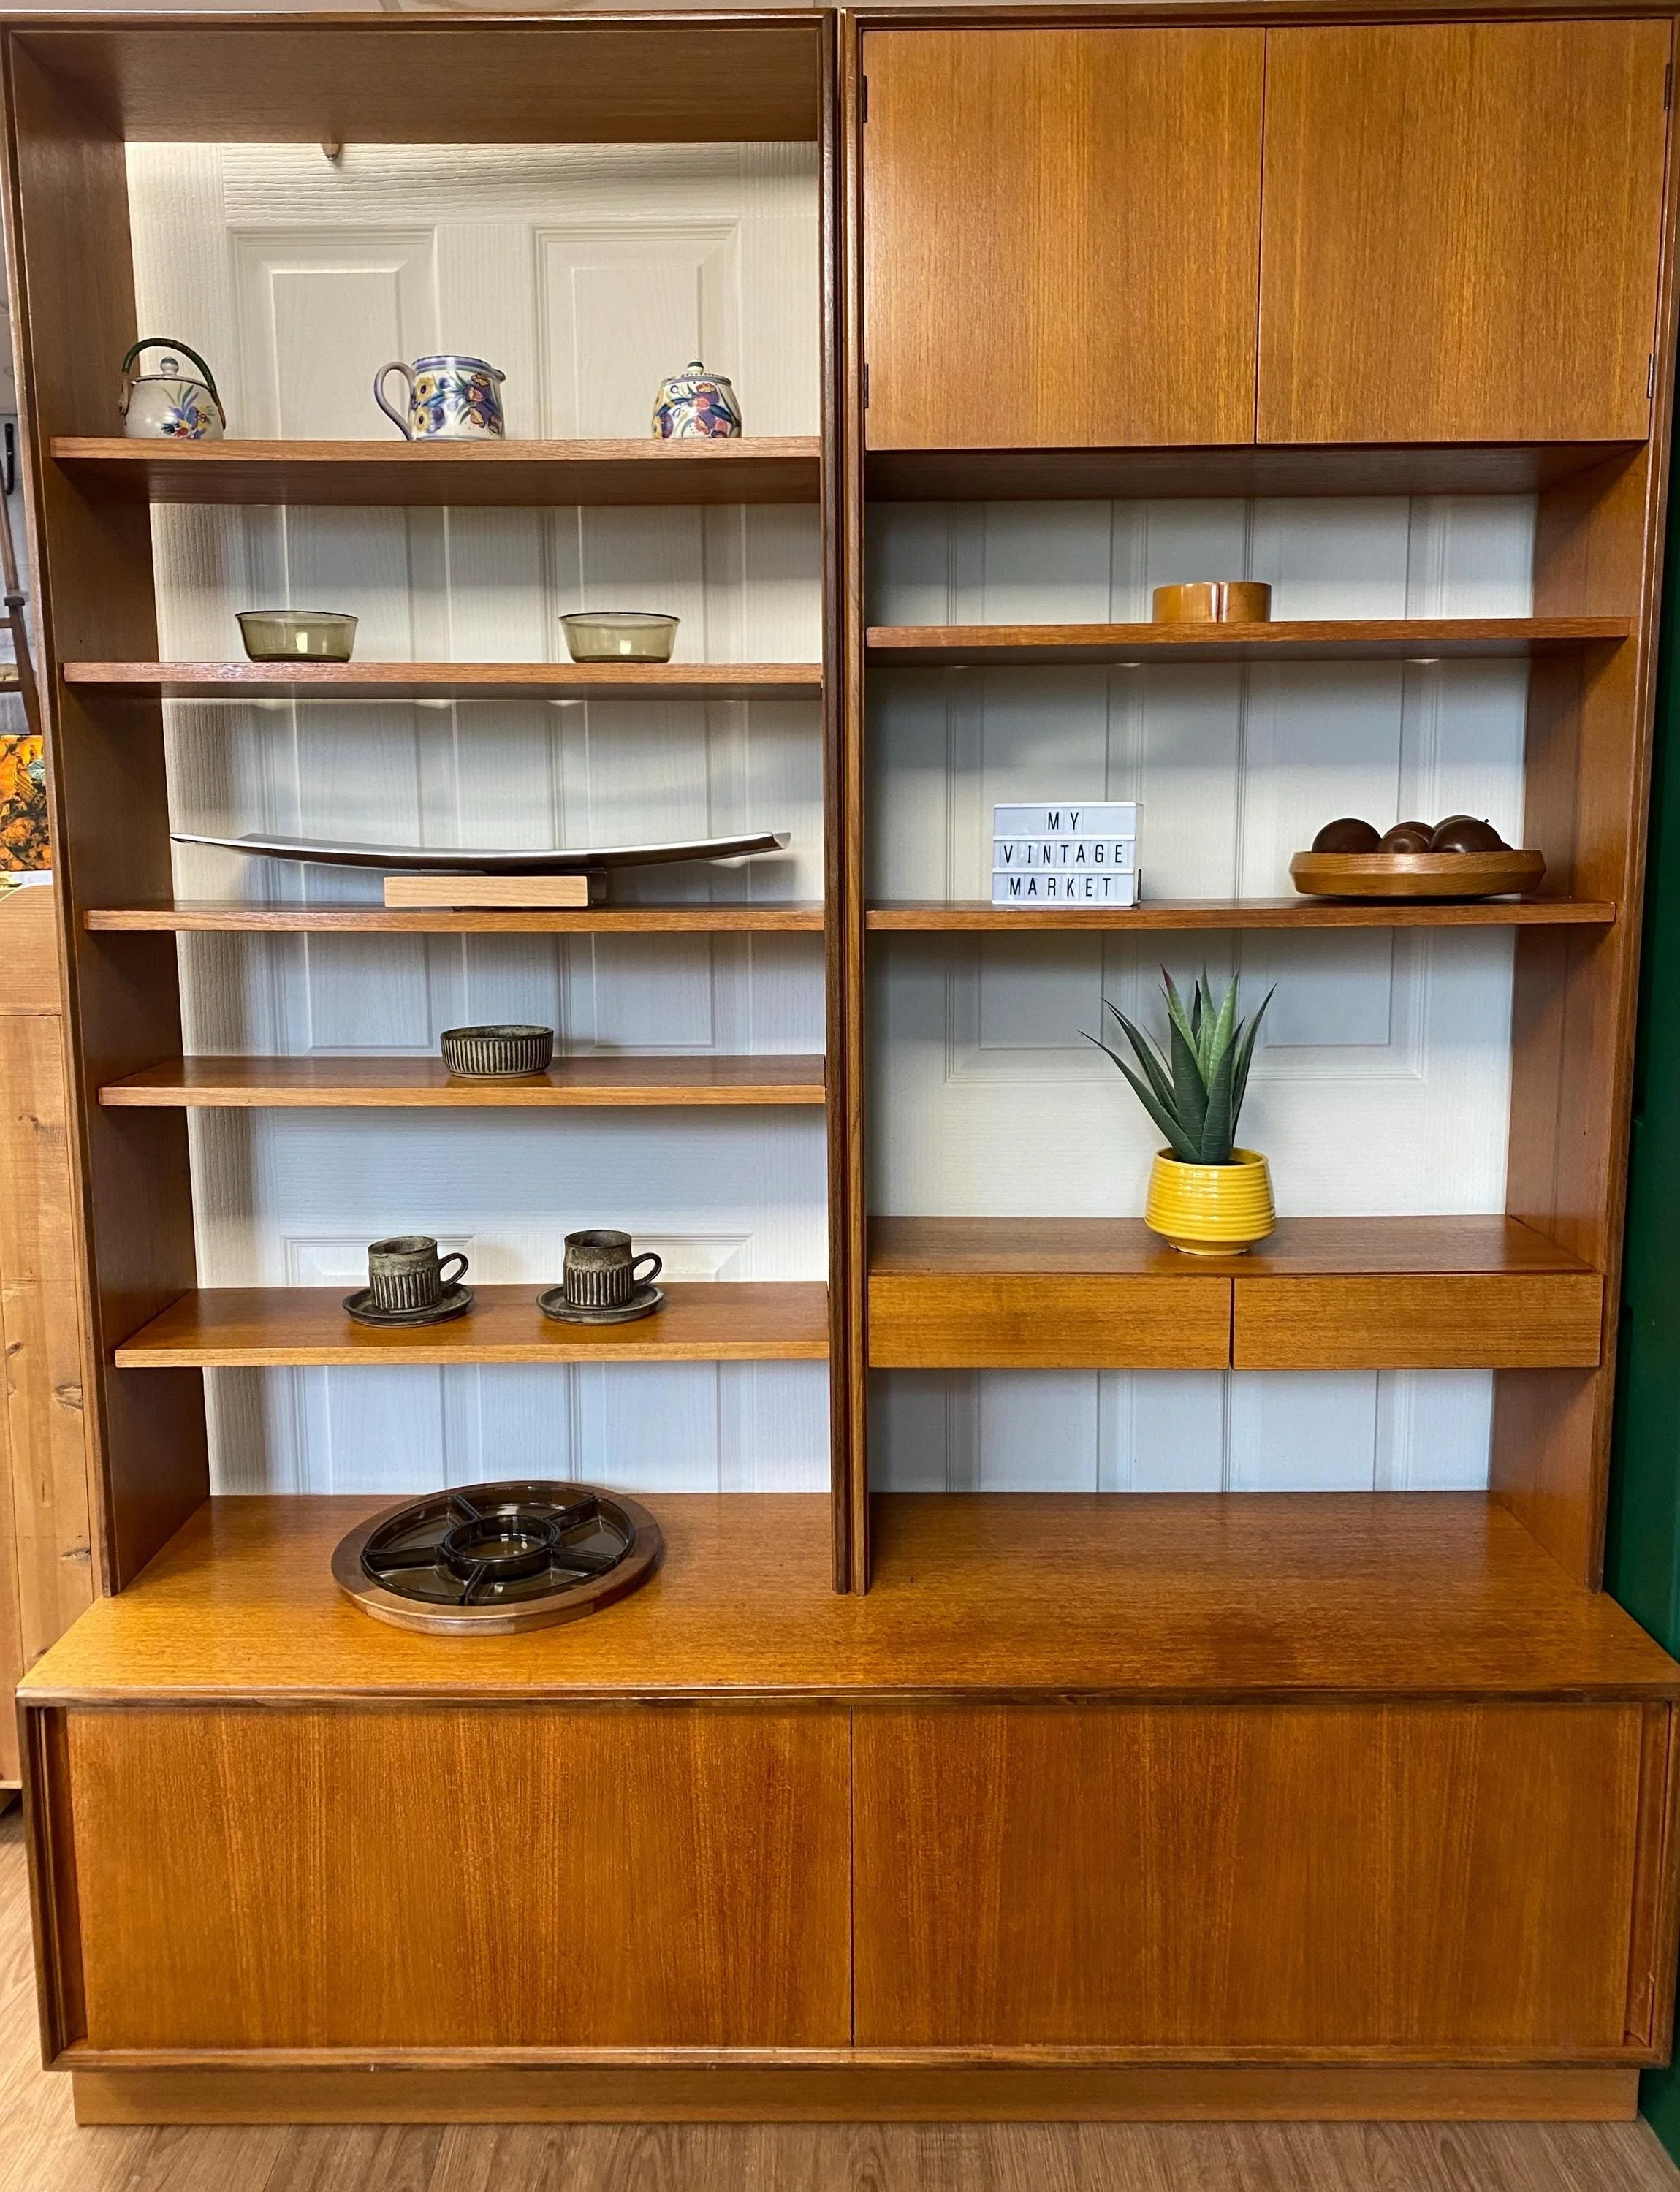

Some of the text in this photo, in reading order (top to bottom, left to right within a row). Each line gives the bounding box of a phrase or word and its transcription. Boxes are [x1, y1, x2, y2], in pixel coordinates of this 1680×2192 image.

[1047, 811, 1079, 831] MY
[1003, 844, 1123, 864] VINTAGE
[1009, 877, 1111, 897] MARKET
